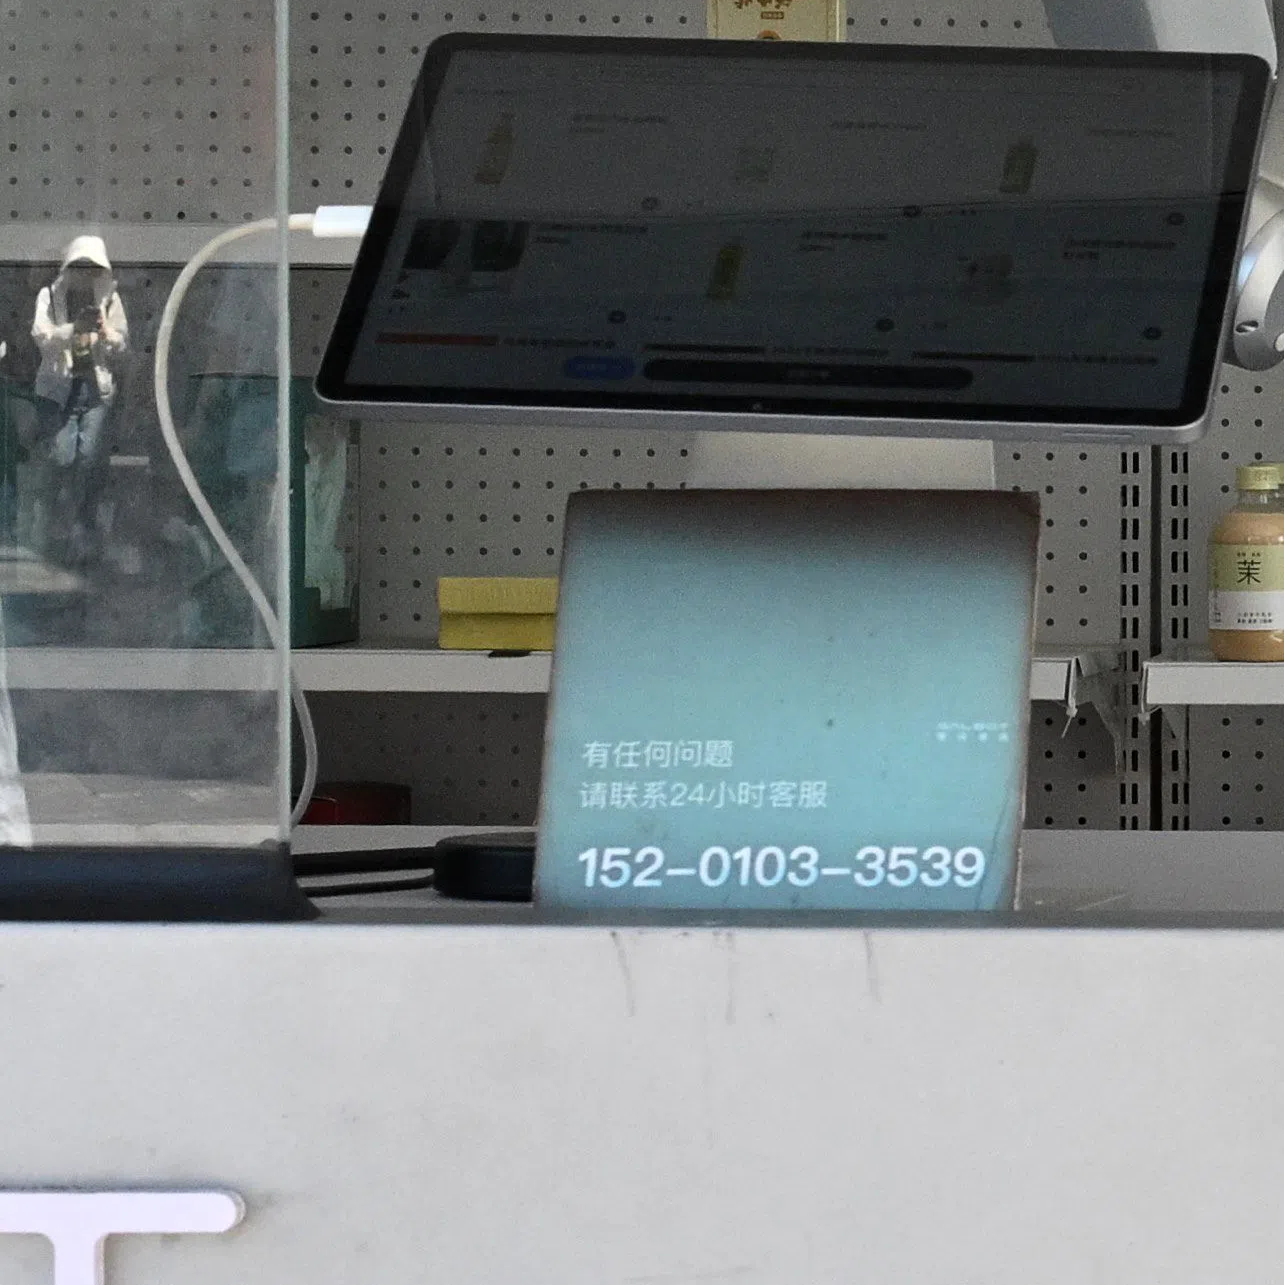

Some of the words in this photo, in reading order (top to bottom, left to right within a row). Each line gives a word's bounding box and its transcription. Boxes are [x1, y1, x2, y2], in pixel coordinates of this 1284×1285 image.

[1235, 559, 1262, 586] 茉
[581, 739, 734, 769] 有任何问题
[579, 780, 828, 810] 请联系24小时客服
[576, 844, 986, 889] 152-0103-3539
